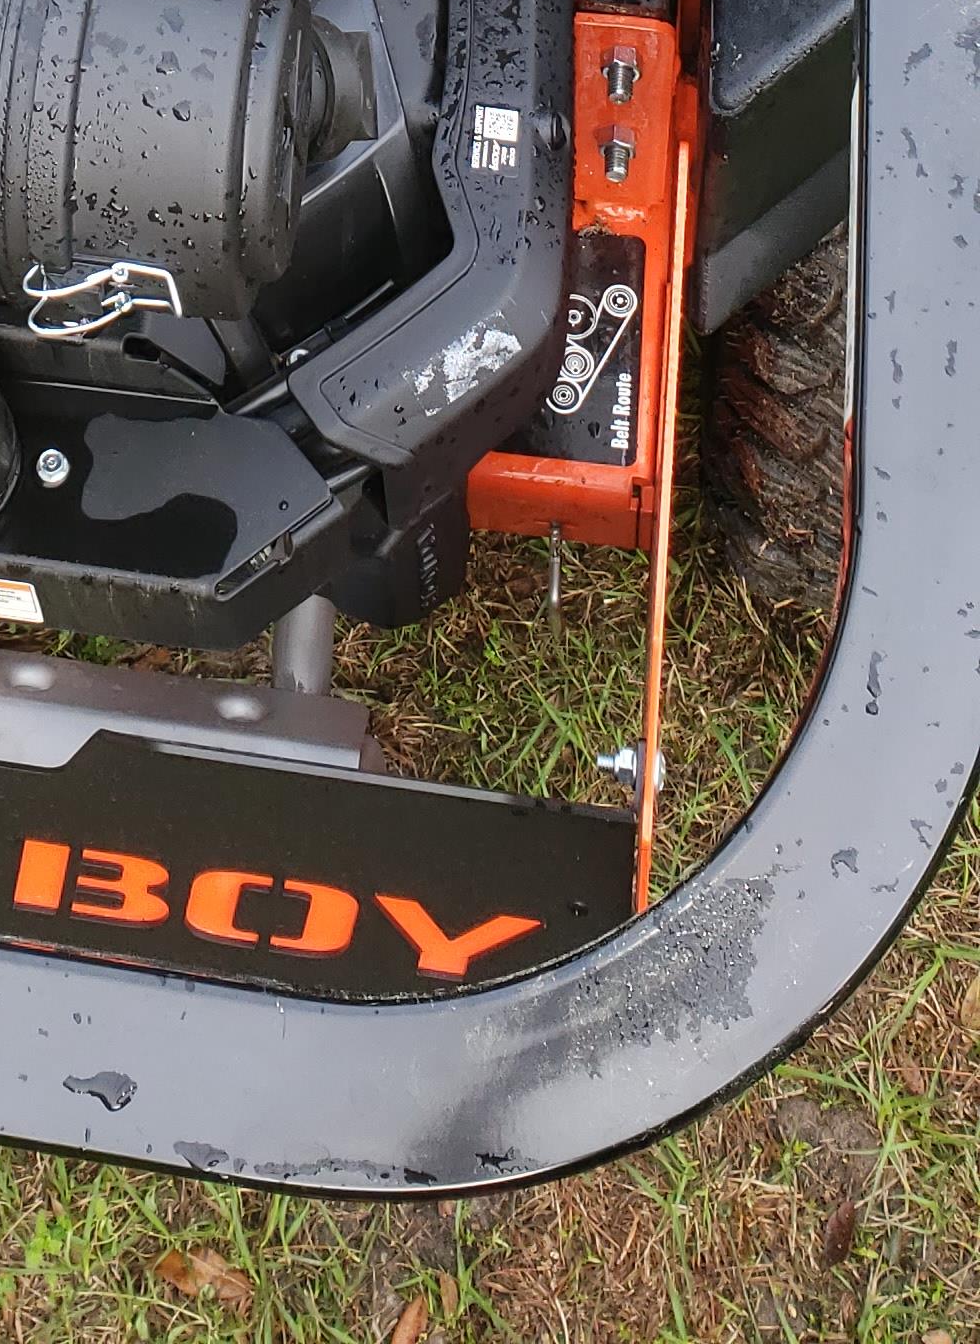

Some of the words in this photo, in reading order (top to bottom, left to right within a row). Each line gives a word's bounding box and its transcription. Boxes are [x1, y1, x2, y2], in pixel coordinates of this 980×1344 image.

[612, 372, 632, 416] Route
[610, 418, 630, 449] Belt
[13, 840, 541, 977] BOY
